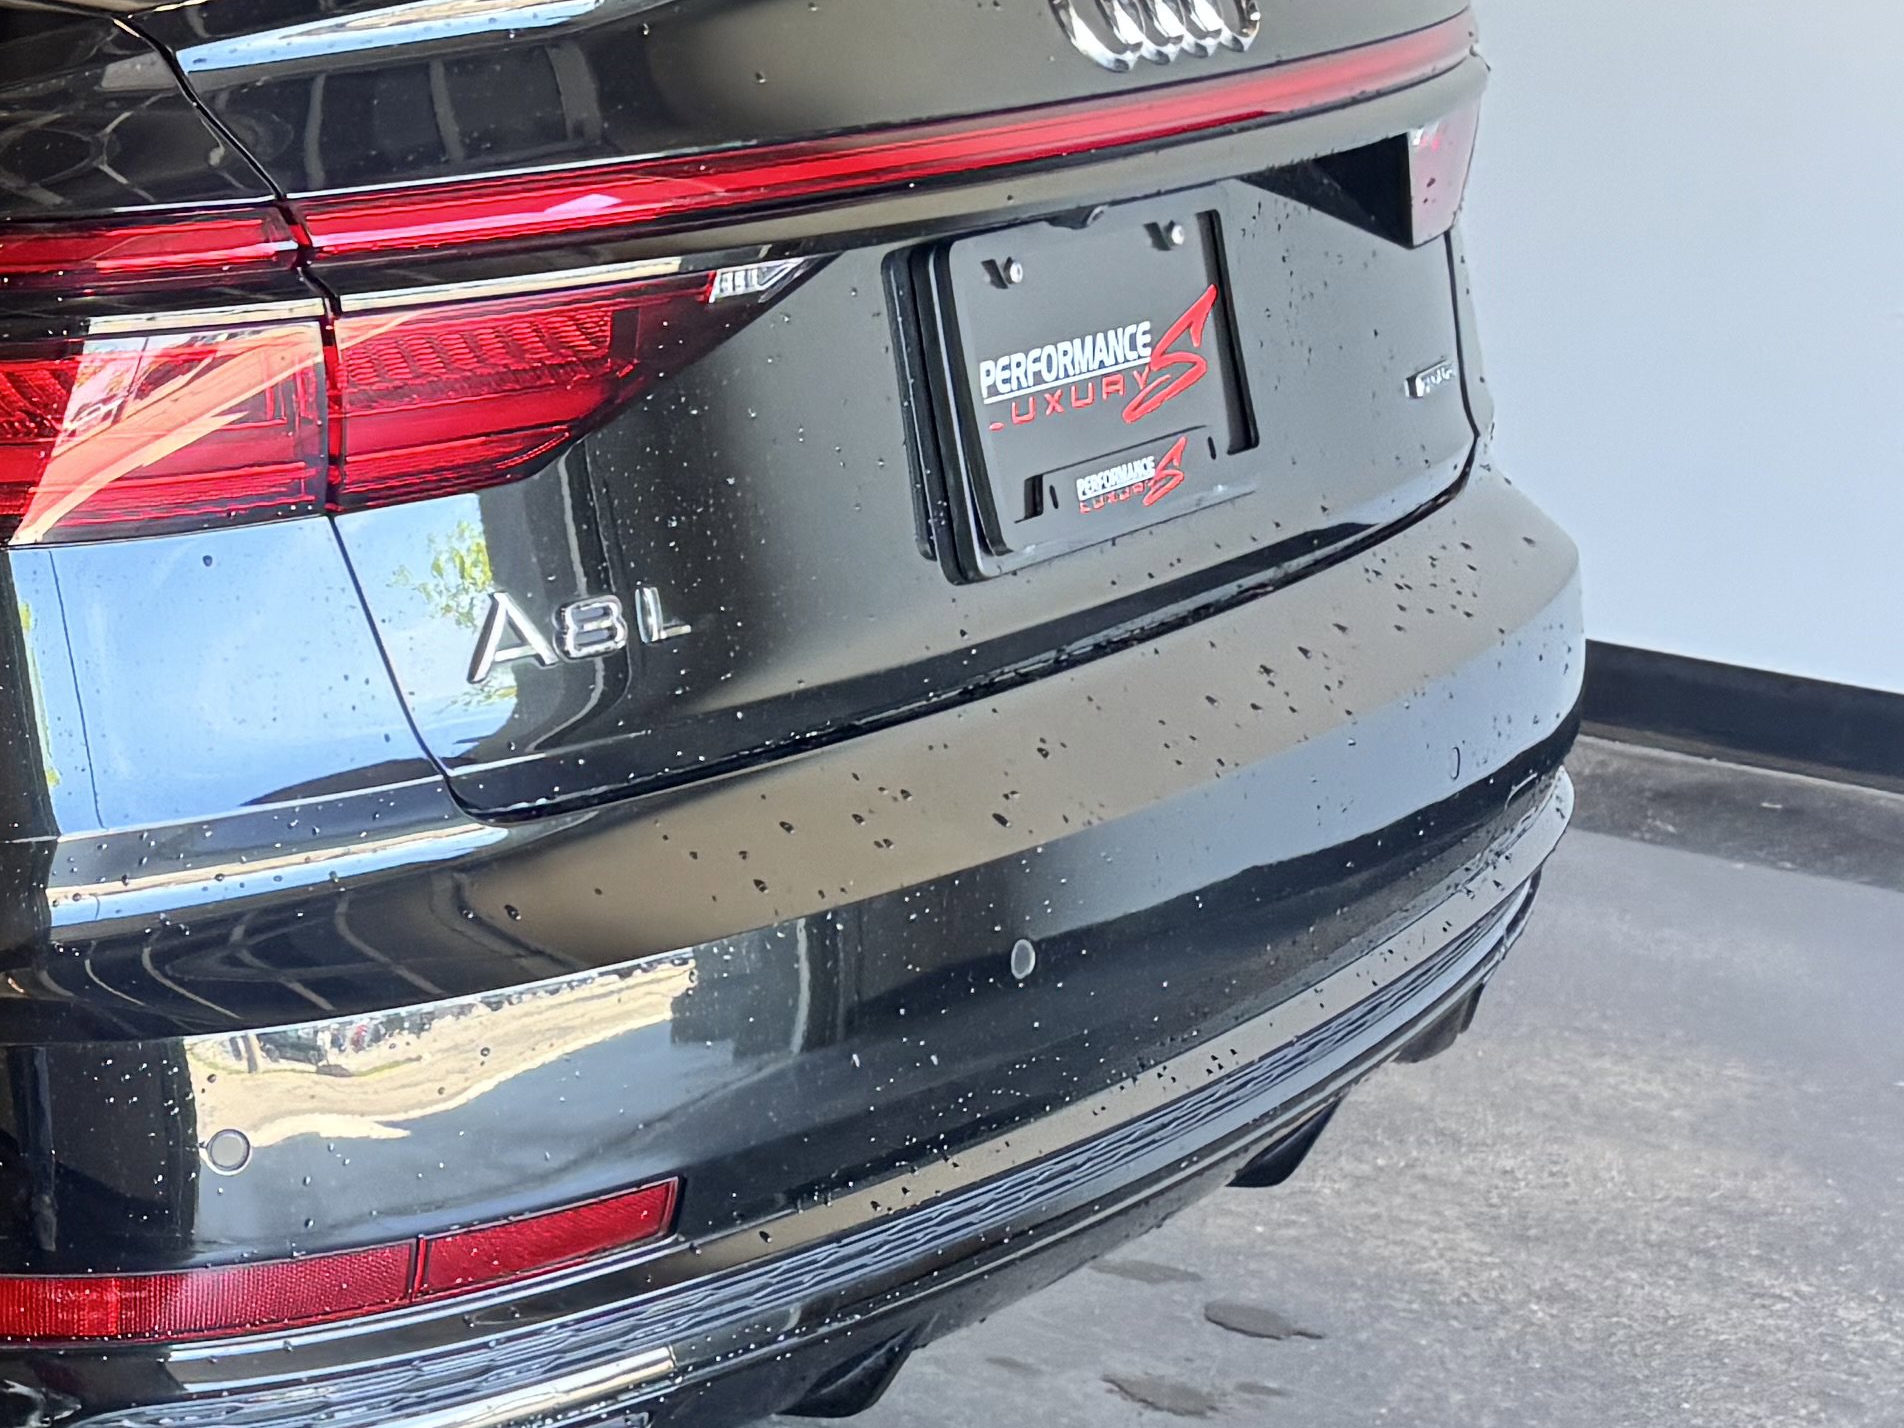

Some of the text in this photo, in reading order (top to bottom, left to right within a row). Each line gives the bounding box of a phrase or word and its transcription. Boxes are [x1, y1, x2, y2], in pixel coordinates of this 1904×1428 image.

[979, 320, 1152, 398] PERFORMANCE
[989, 365, 1152, 432] UXURY
[1076, 455, 1156, 498] PERFORMANCE
